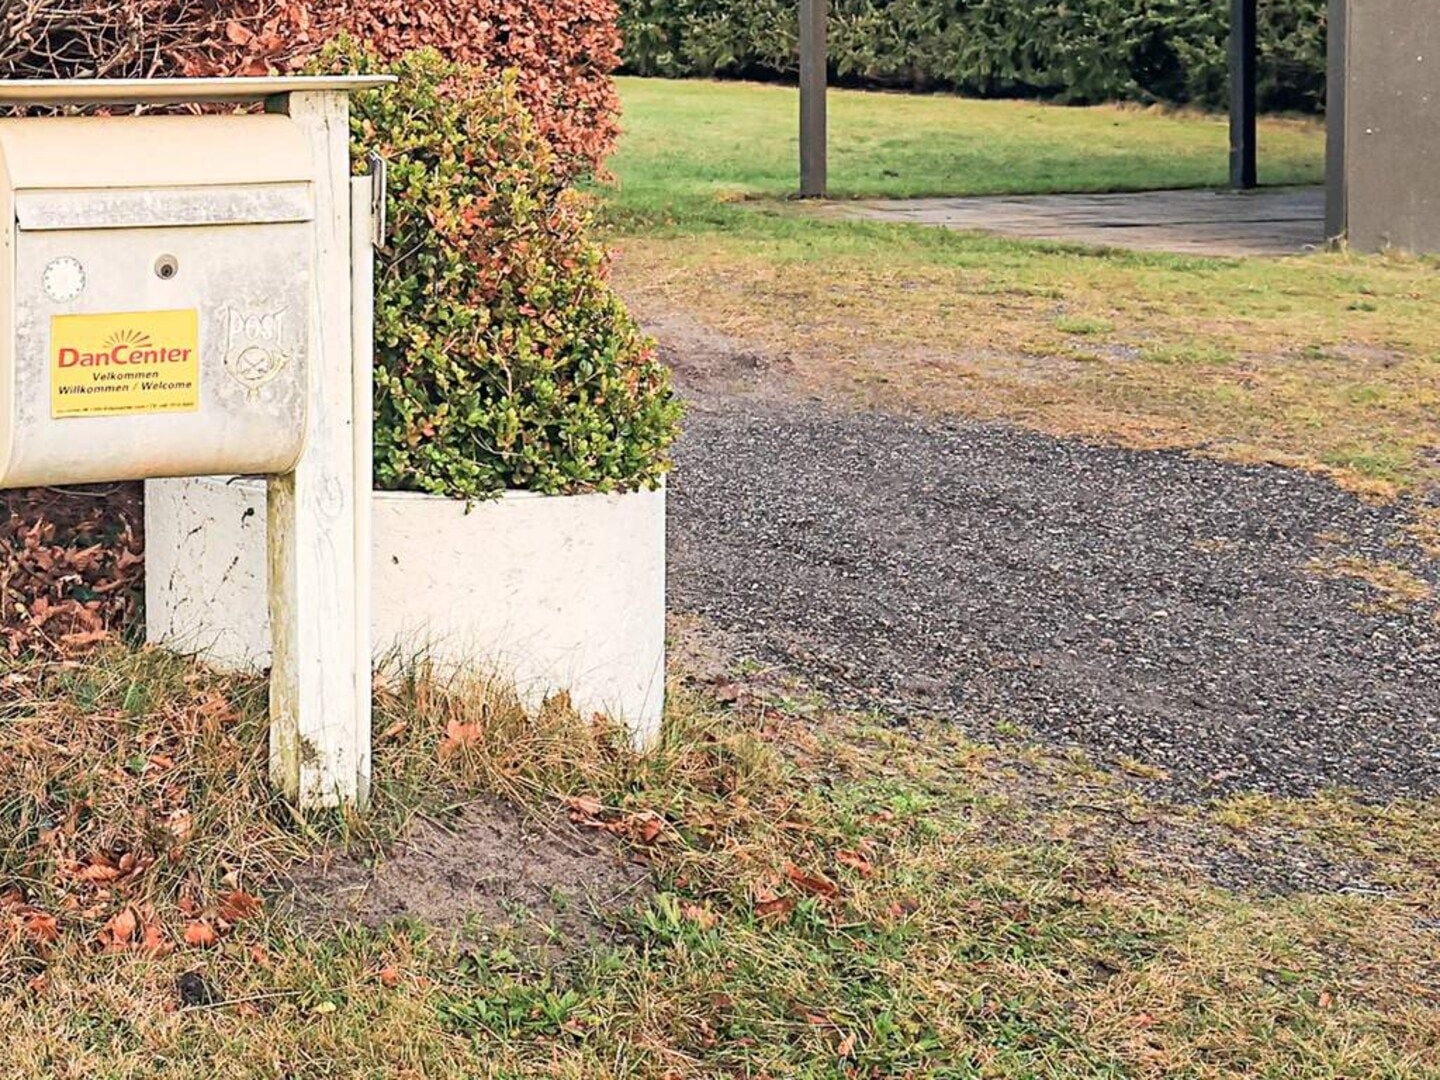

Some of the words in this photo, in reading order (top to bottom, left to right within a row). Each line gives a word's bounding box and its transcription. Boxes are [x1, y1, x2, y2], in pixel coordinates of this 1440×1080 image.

[58, 345, 192, 368] DanCenter
[92, 371, 159, 381] Velkommen
[58, 384, 129, 395] Willkommen
[141, 381, 192, 391] Welcome
